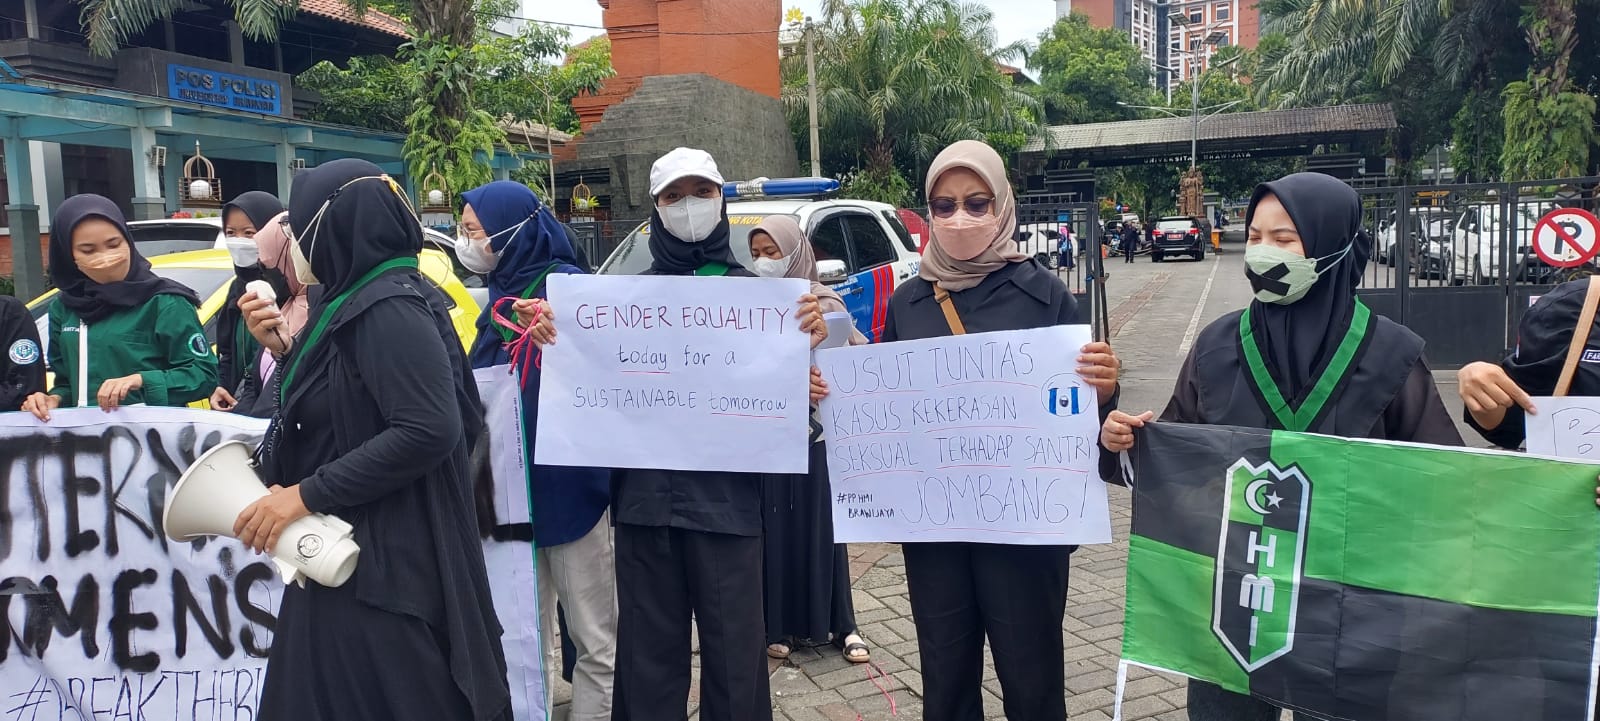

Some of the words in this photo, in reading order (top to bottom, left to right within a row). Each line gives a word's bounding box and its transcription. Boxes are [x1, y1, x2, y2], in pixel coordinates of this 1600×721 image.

[175, 68, 214, 90] POS
[219, 75, 277, 99] POLISI
[575, 303, 673, 330] GENDER
[682, 305, 790, 335] EQUALITY
[617, 344, 668, 371] today
[684, 344, 711, 367] for
[724, 350, 736, 367] a
[830, 350, 915, 394] USUT
[928, 341, 1035, 385] TUNTAS
[573, 386, 697, 409] SUSTAINABLE
[708, 391, 788, 412] tomorrow
[831, 400, 904, 437] KASUS
[911, 395, 1018, 426] KEKERASAN
[834, 440, 919, 474] SEKSUAL
[935, 435, 1014, 463] TERHADAP
[1024, 434, 1092, 464] SANTRI
[848, 506, 896, 519] BRAWIJAYA
[1239, 530, 1278, 647] HMI
